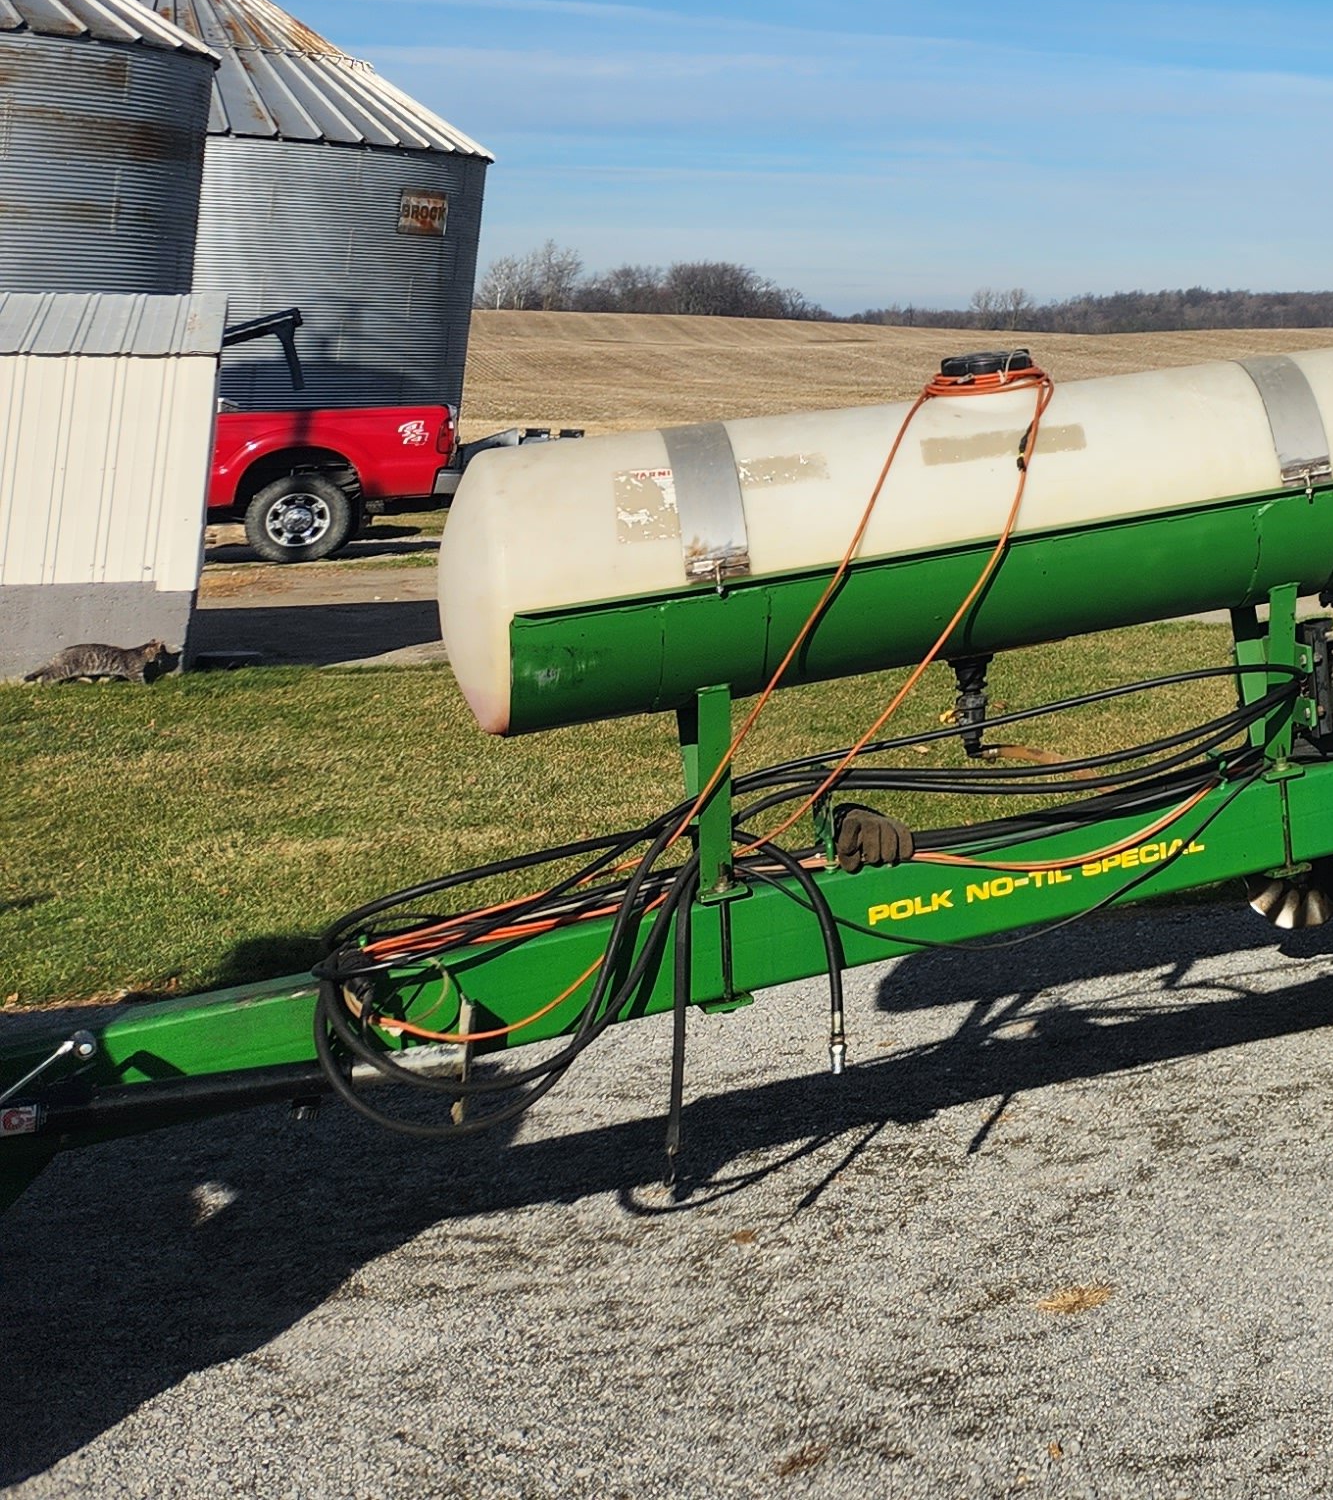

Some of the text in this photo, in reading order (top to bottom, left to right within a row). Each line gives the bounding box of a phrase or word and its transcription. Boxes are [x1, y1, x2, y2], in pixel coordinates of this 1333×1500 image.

[402, 203, 446, 221] BROCK
[868, 838, 1205, 926] POLK NO-TIL SPECIAL
